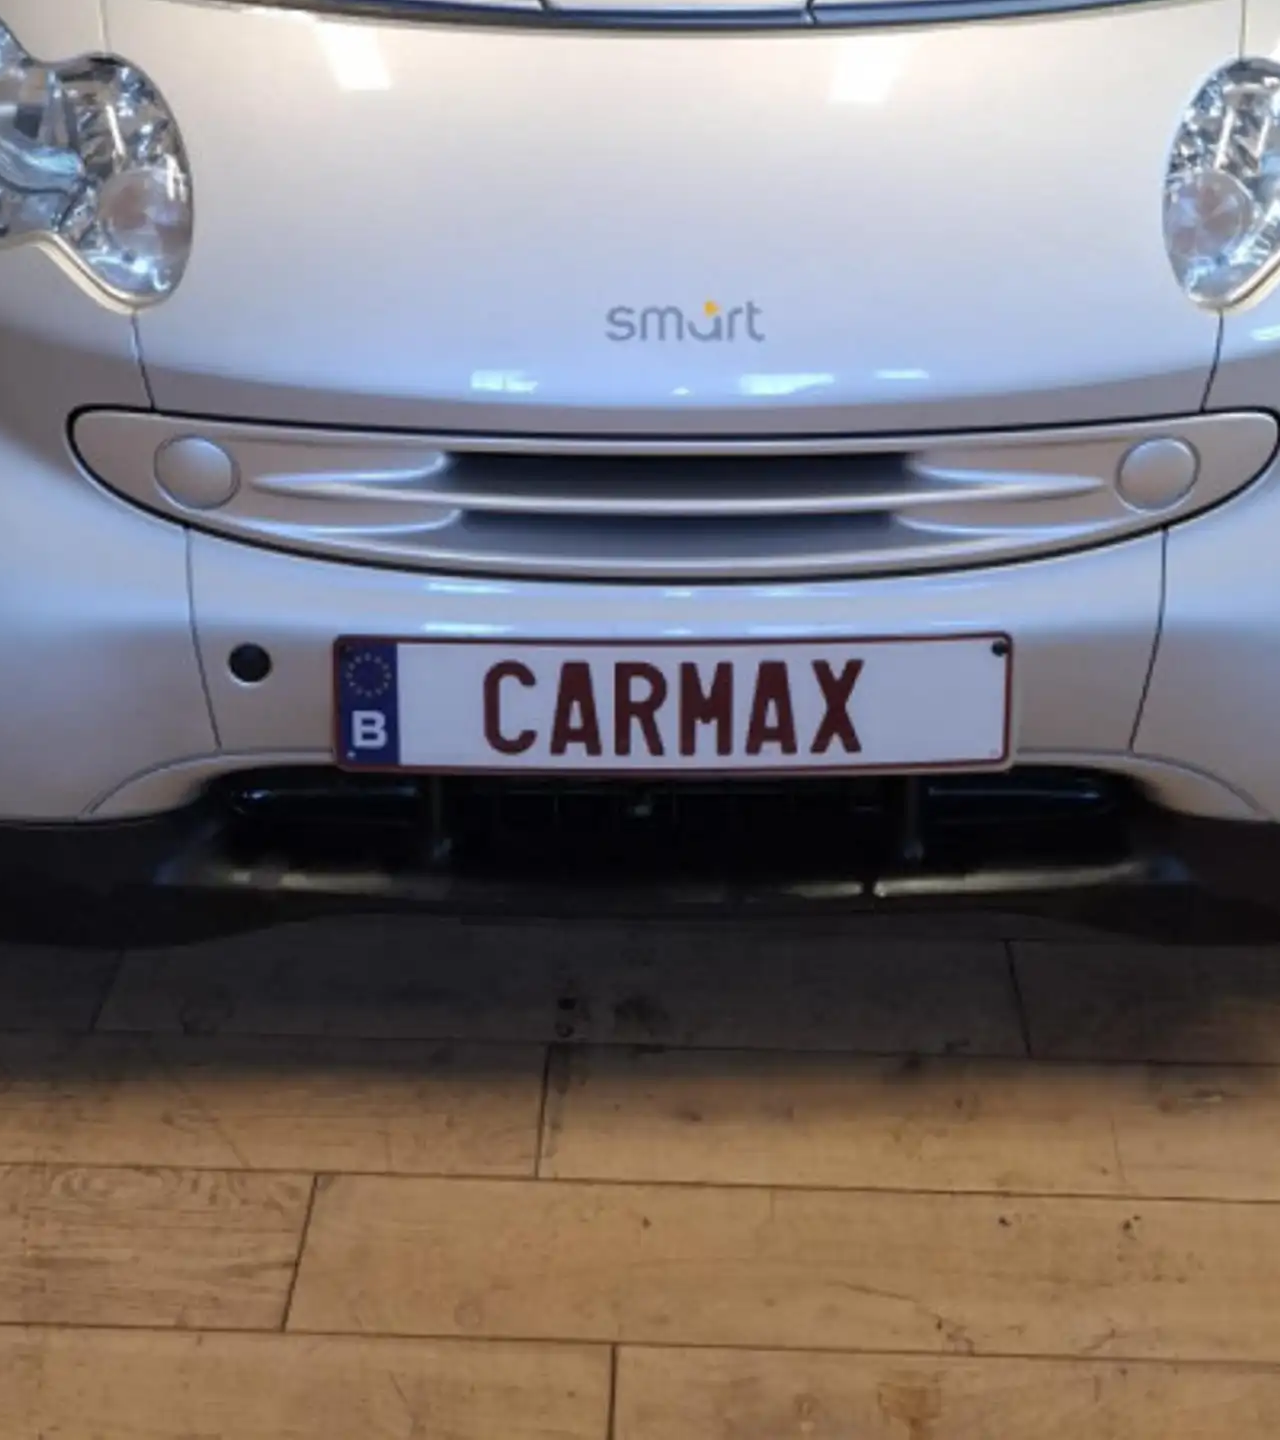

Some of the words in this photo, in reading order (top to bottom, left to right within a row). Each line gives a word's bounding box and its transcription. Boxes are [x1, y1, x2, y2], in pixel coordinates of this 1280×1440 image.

[604, 299, 766, 342] smart
[351, 710, 388, 748] B
[482, 659, 864, 756] CARMAX
